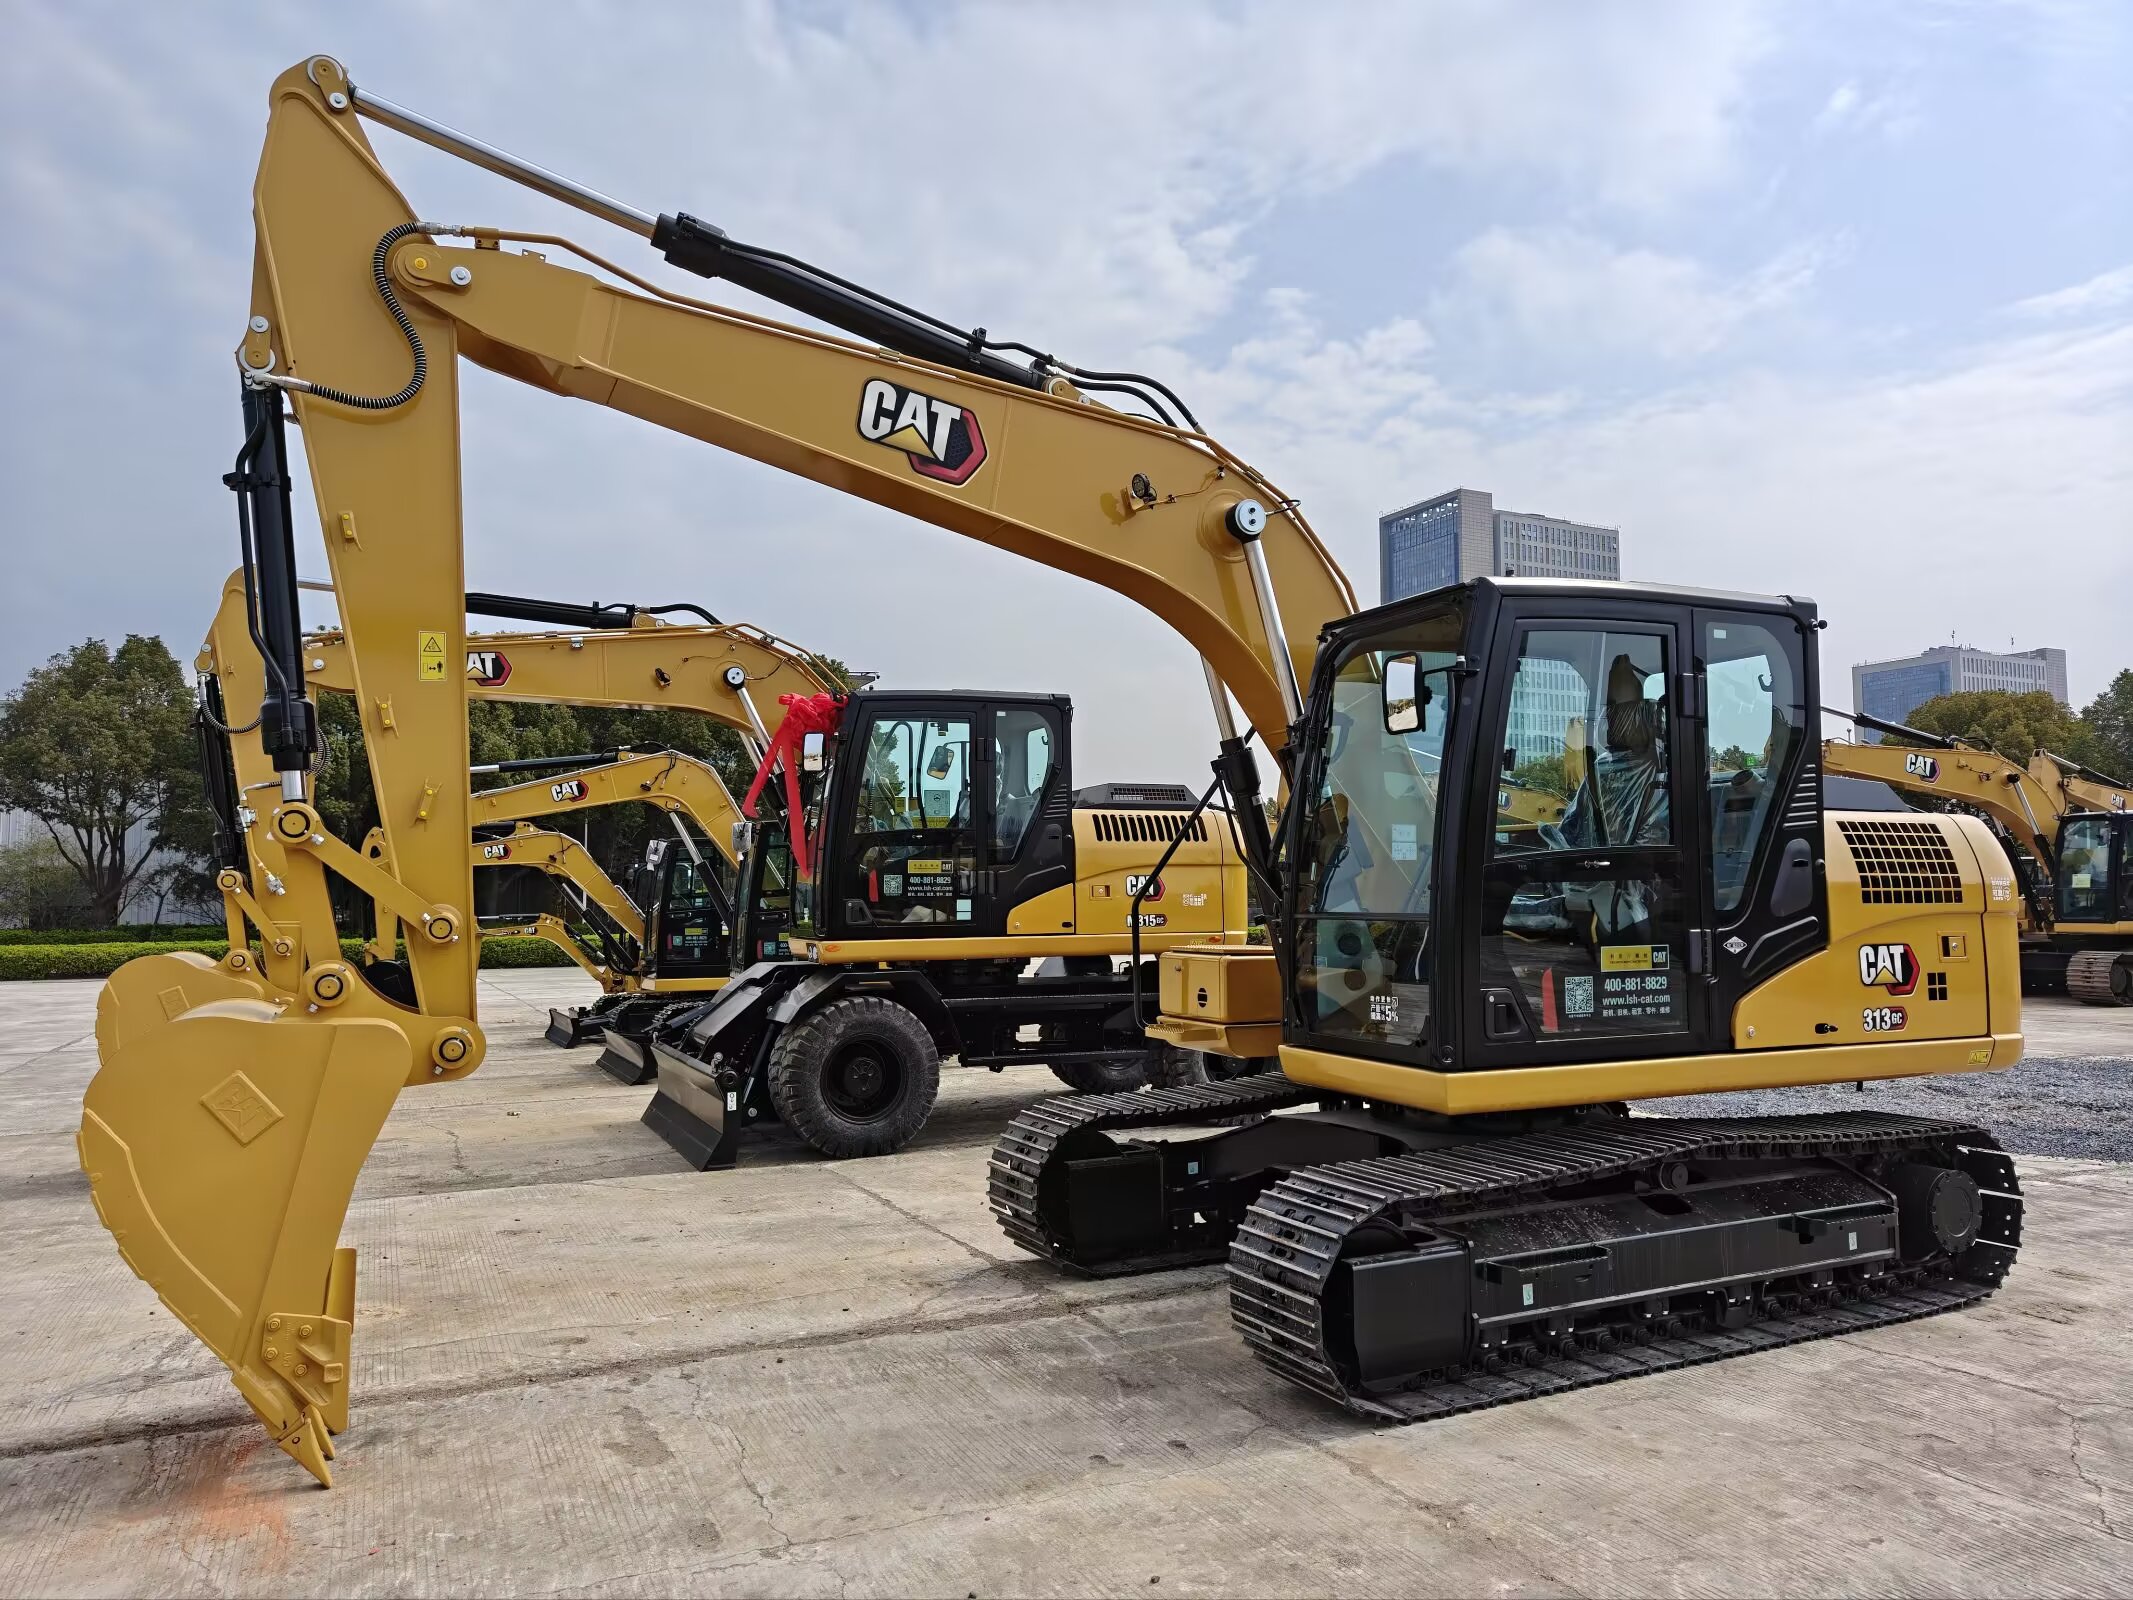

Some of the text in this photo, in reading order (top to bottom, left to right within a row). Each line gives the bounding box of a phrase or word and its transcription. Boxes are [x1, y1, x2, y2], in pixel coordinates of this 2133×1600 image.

[860, 380, 962, 462] CAT
[467, 652, 496, 678] AT
[1906, 753, 1934, 777] CAT
[551, 781, 579, 801] CAT
[2111, 793, 2124, 809] CAT
[484, 844, 504, 859] CAT
[524, 927, 535, 935] CAT
[1653, 951, 1667, 963] CAT
[1860, 945, 1904, 985] CAT
[1604, 976, 1667, 991] 400-881-8829
[1602, 994, 1671, 1007] www.lsh-cat.com
[1863, 1008, 1903, 1031] 313 GC
